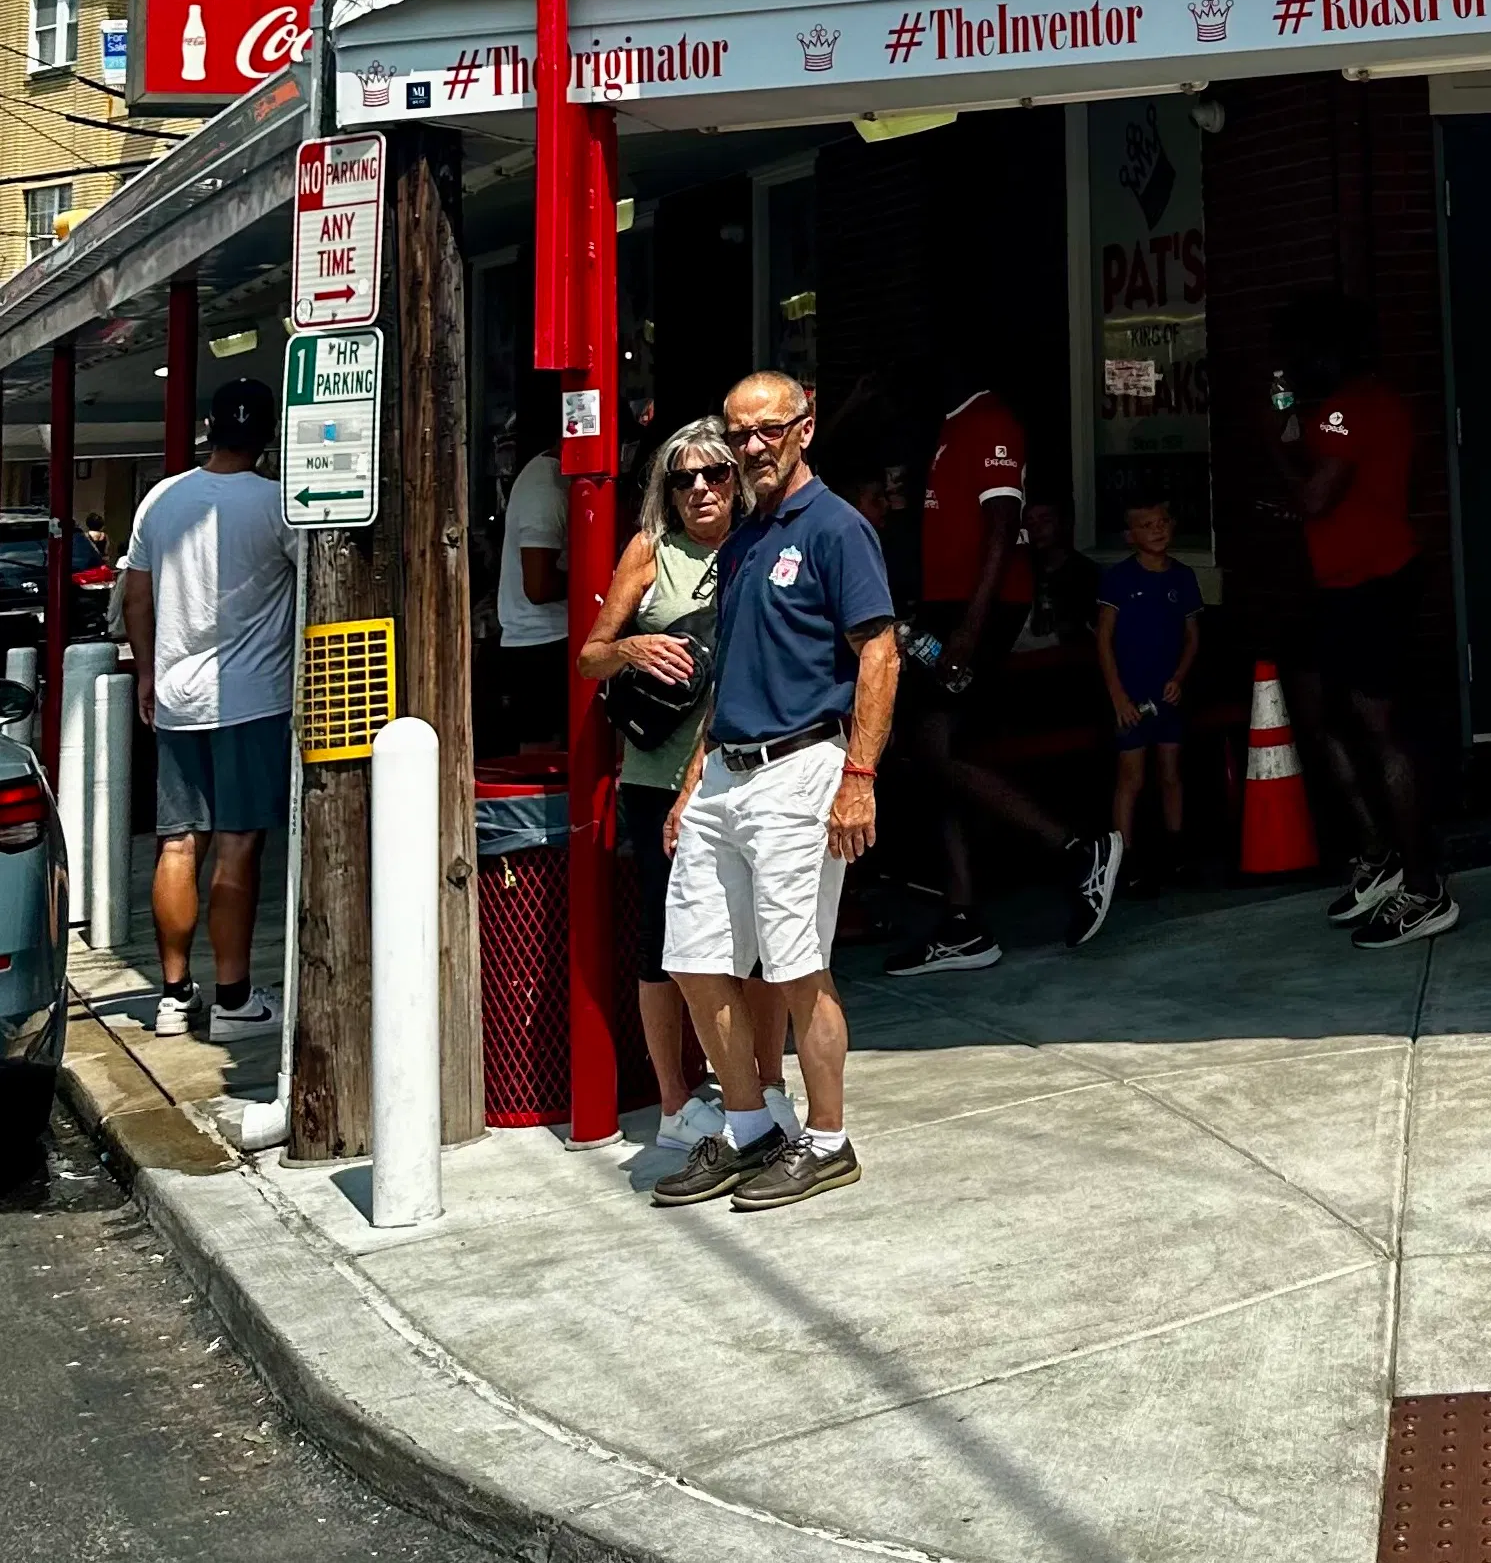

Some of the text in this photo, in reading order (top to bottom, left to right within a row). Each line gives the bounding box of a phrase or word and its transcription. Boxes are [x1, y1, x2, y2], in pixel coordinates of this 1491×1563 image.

[300, 156, 378, 196] NO PARKING
[320, 212, 357, 244] ANY
[318, 248, 357, 278] TIME
[1103, 228, 1207, 314] PAT'S
[336, 341, 360, 366] HR
[296, 347, 306, 395] 1
[316, 369, 373, 397] PARKING
